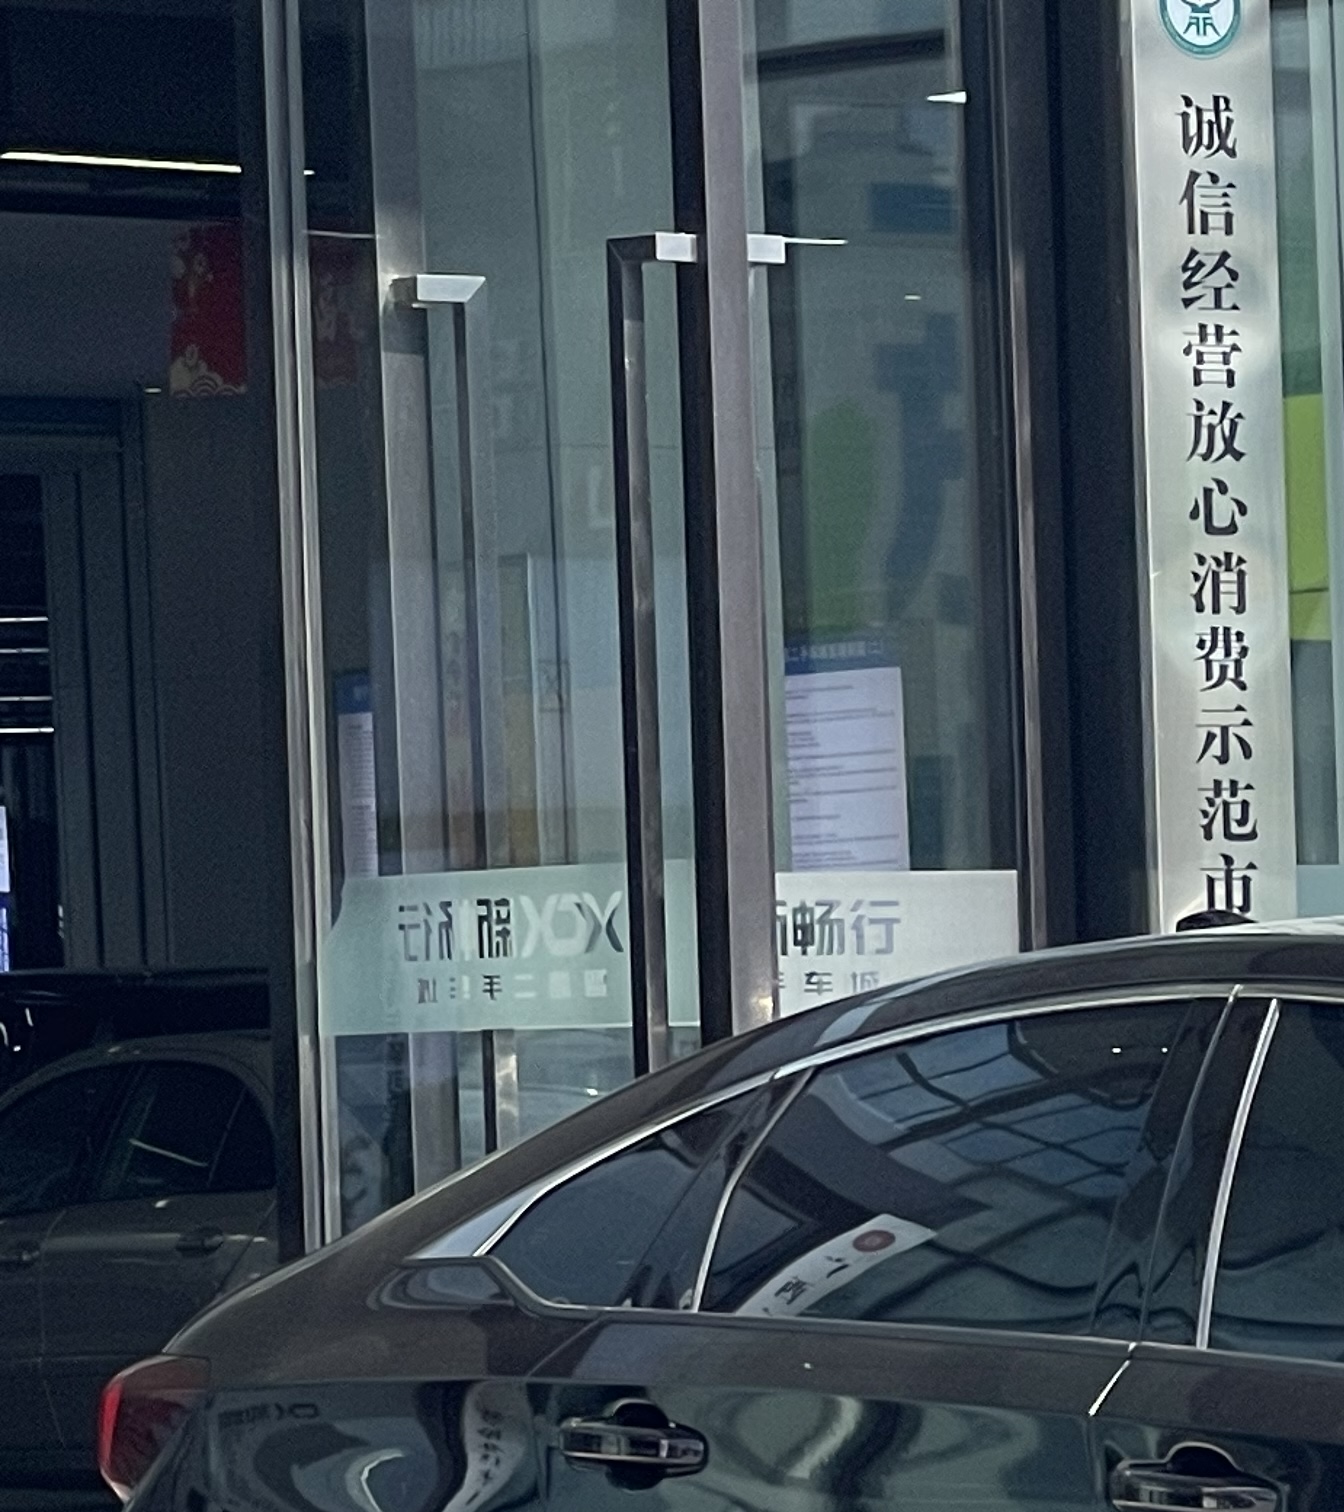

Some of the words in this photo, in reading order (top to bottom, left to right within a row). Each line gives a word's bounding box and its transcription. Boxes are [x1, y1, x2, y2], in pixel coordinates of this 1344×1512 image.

[1175, 94, 1258, 915] 诚信经营放心消费示范市
